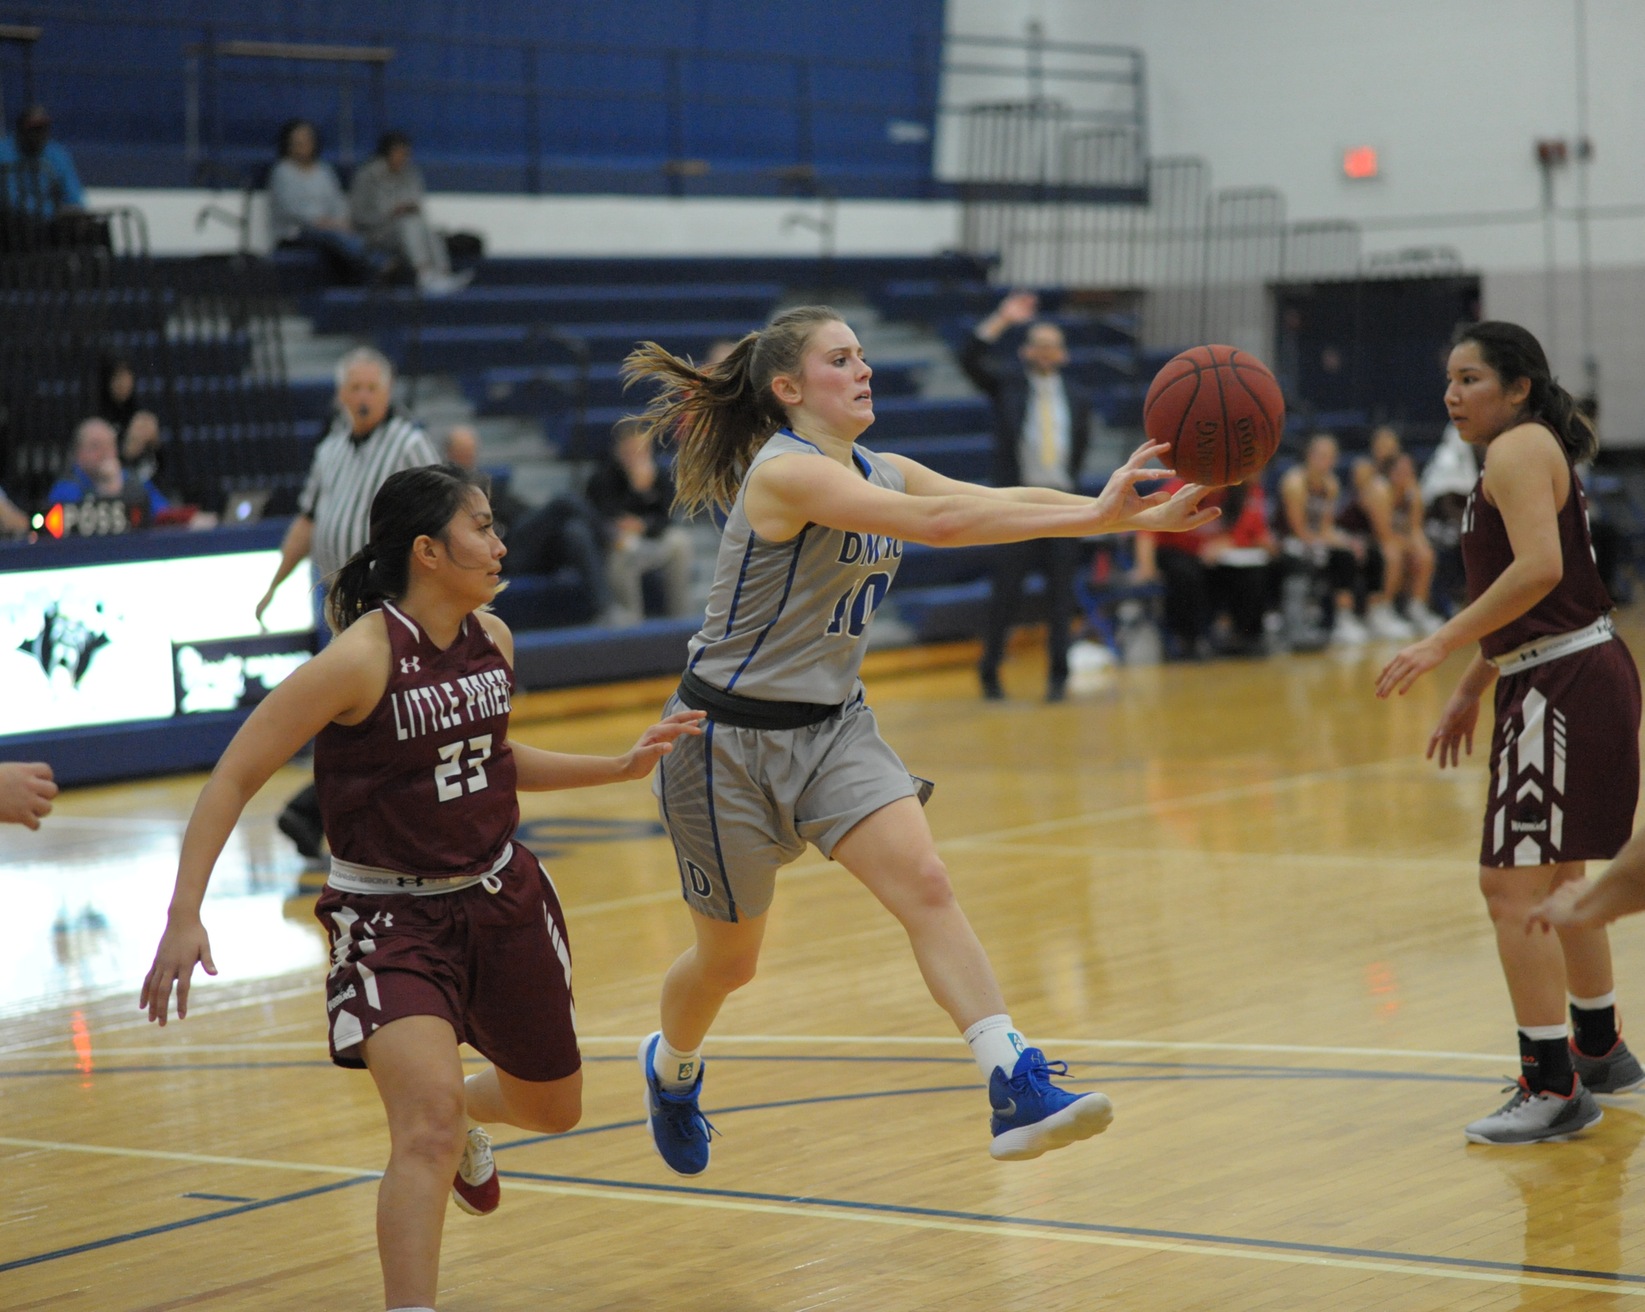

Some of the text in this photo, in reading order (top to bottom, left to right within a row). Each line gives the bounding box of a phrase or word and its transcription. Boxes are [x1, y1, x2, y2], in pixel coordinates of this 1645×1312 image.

[825, 570, 891, 638] 10
[391, 682, 462, 741] LITTLE
[434, 733, 493, 802] 23
[684, 857, 712, 899] D
